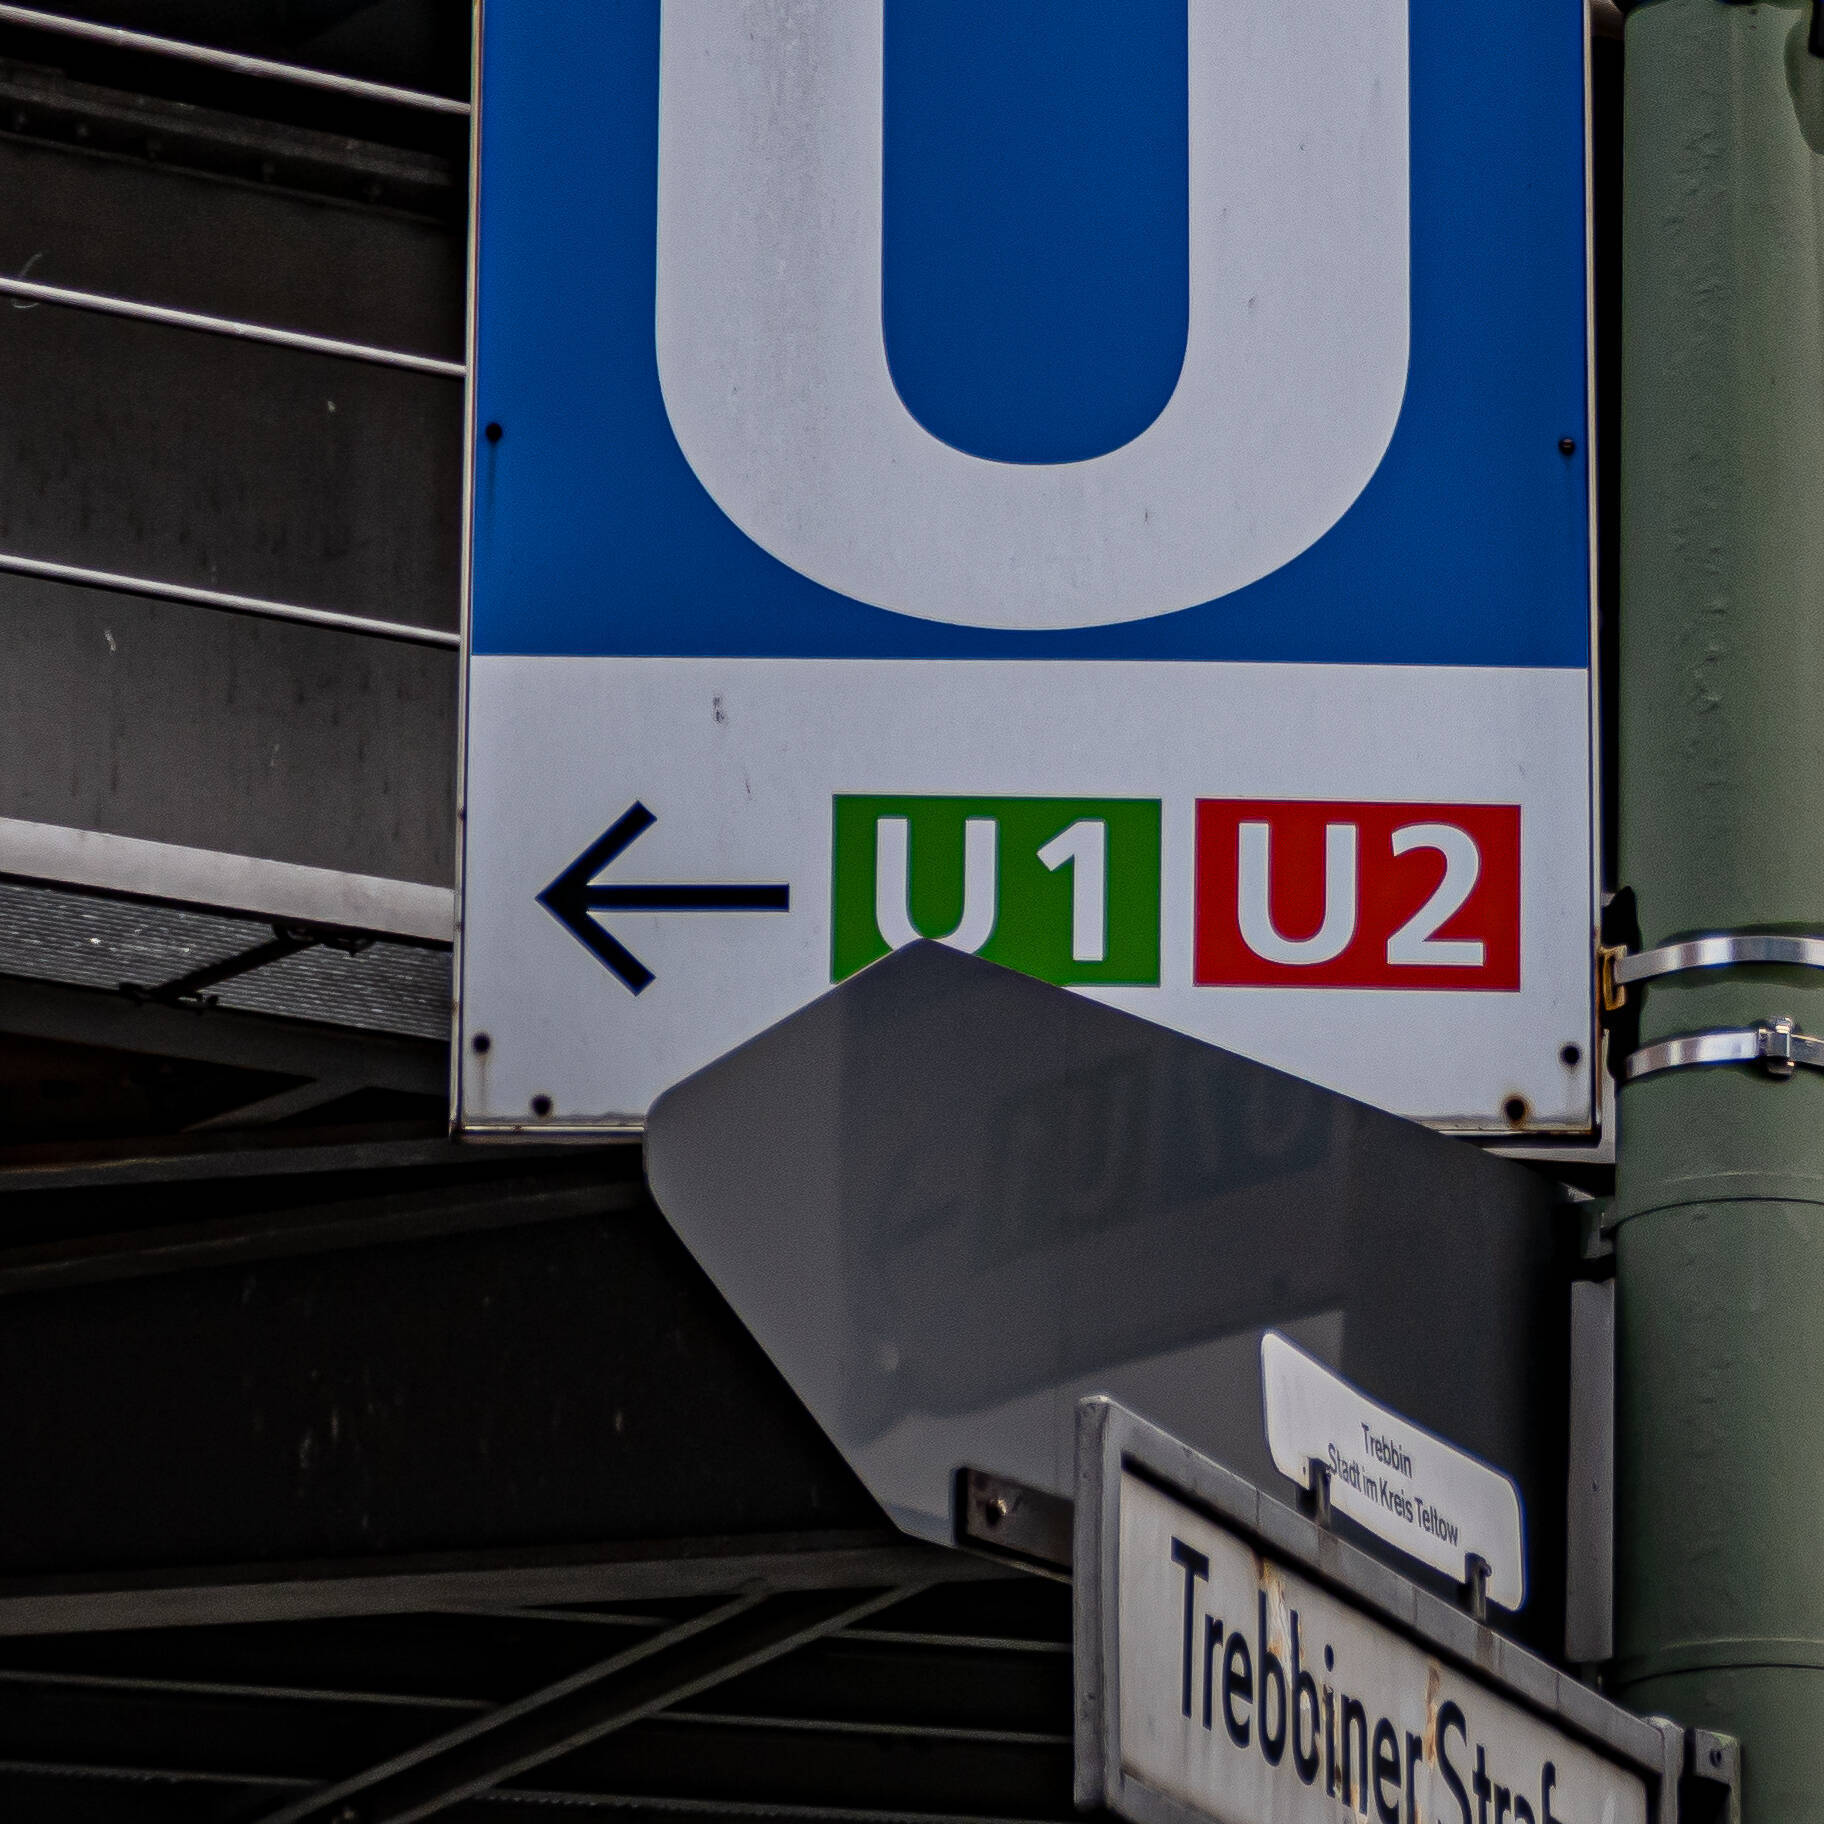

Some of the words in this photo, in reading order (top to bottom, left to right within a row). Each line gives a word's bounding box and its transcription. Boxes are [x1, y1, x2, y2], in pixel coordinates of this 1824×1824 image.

[875, 816, 1106, 962] U1
[1237, 821, 1485, 967] U2
[1327, 1442, 1362, 1493] Stadt
[1362, 1469, 1379, 1504] im
[1379, 1477, 1414, 1524] Kreis
[1414, 1496, 1459, 1548] Teltow
[1361, 1422, 1413, 1479] Trebbin
[1171, 1535, 1423, 1824] Trebbiner
